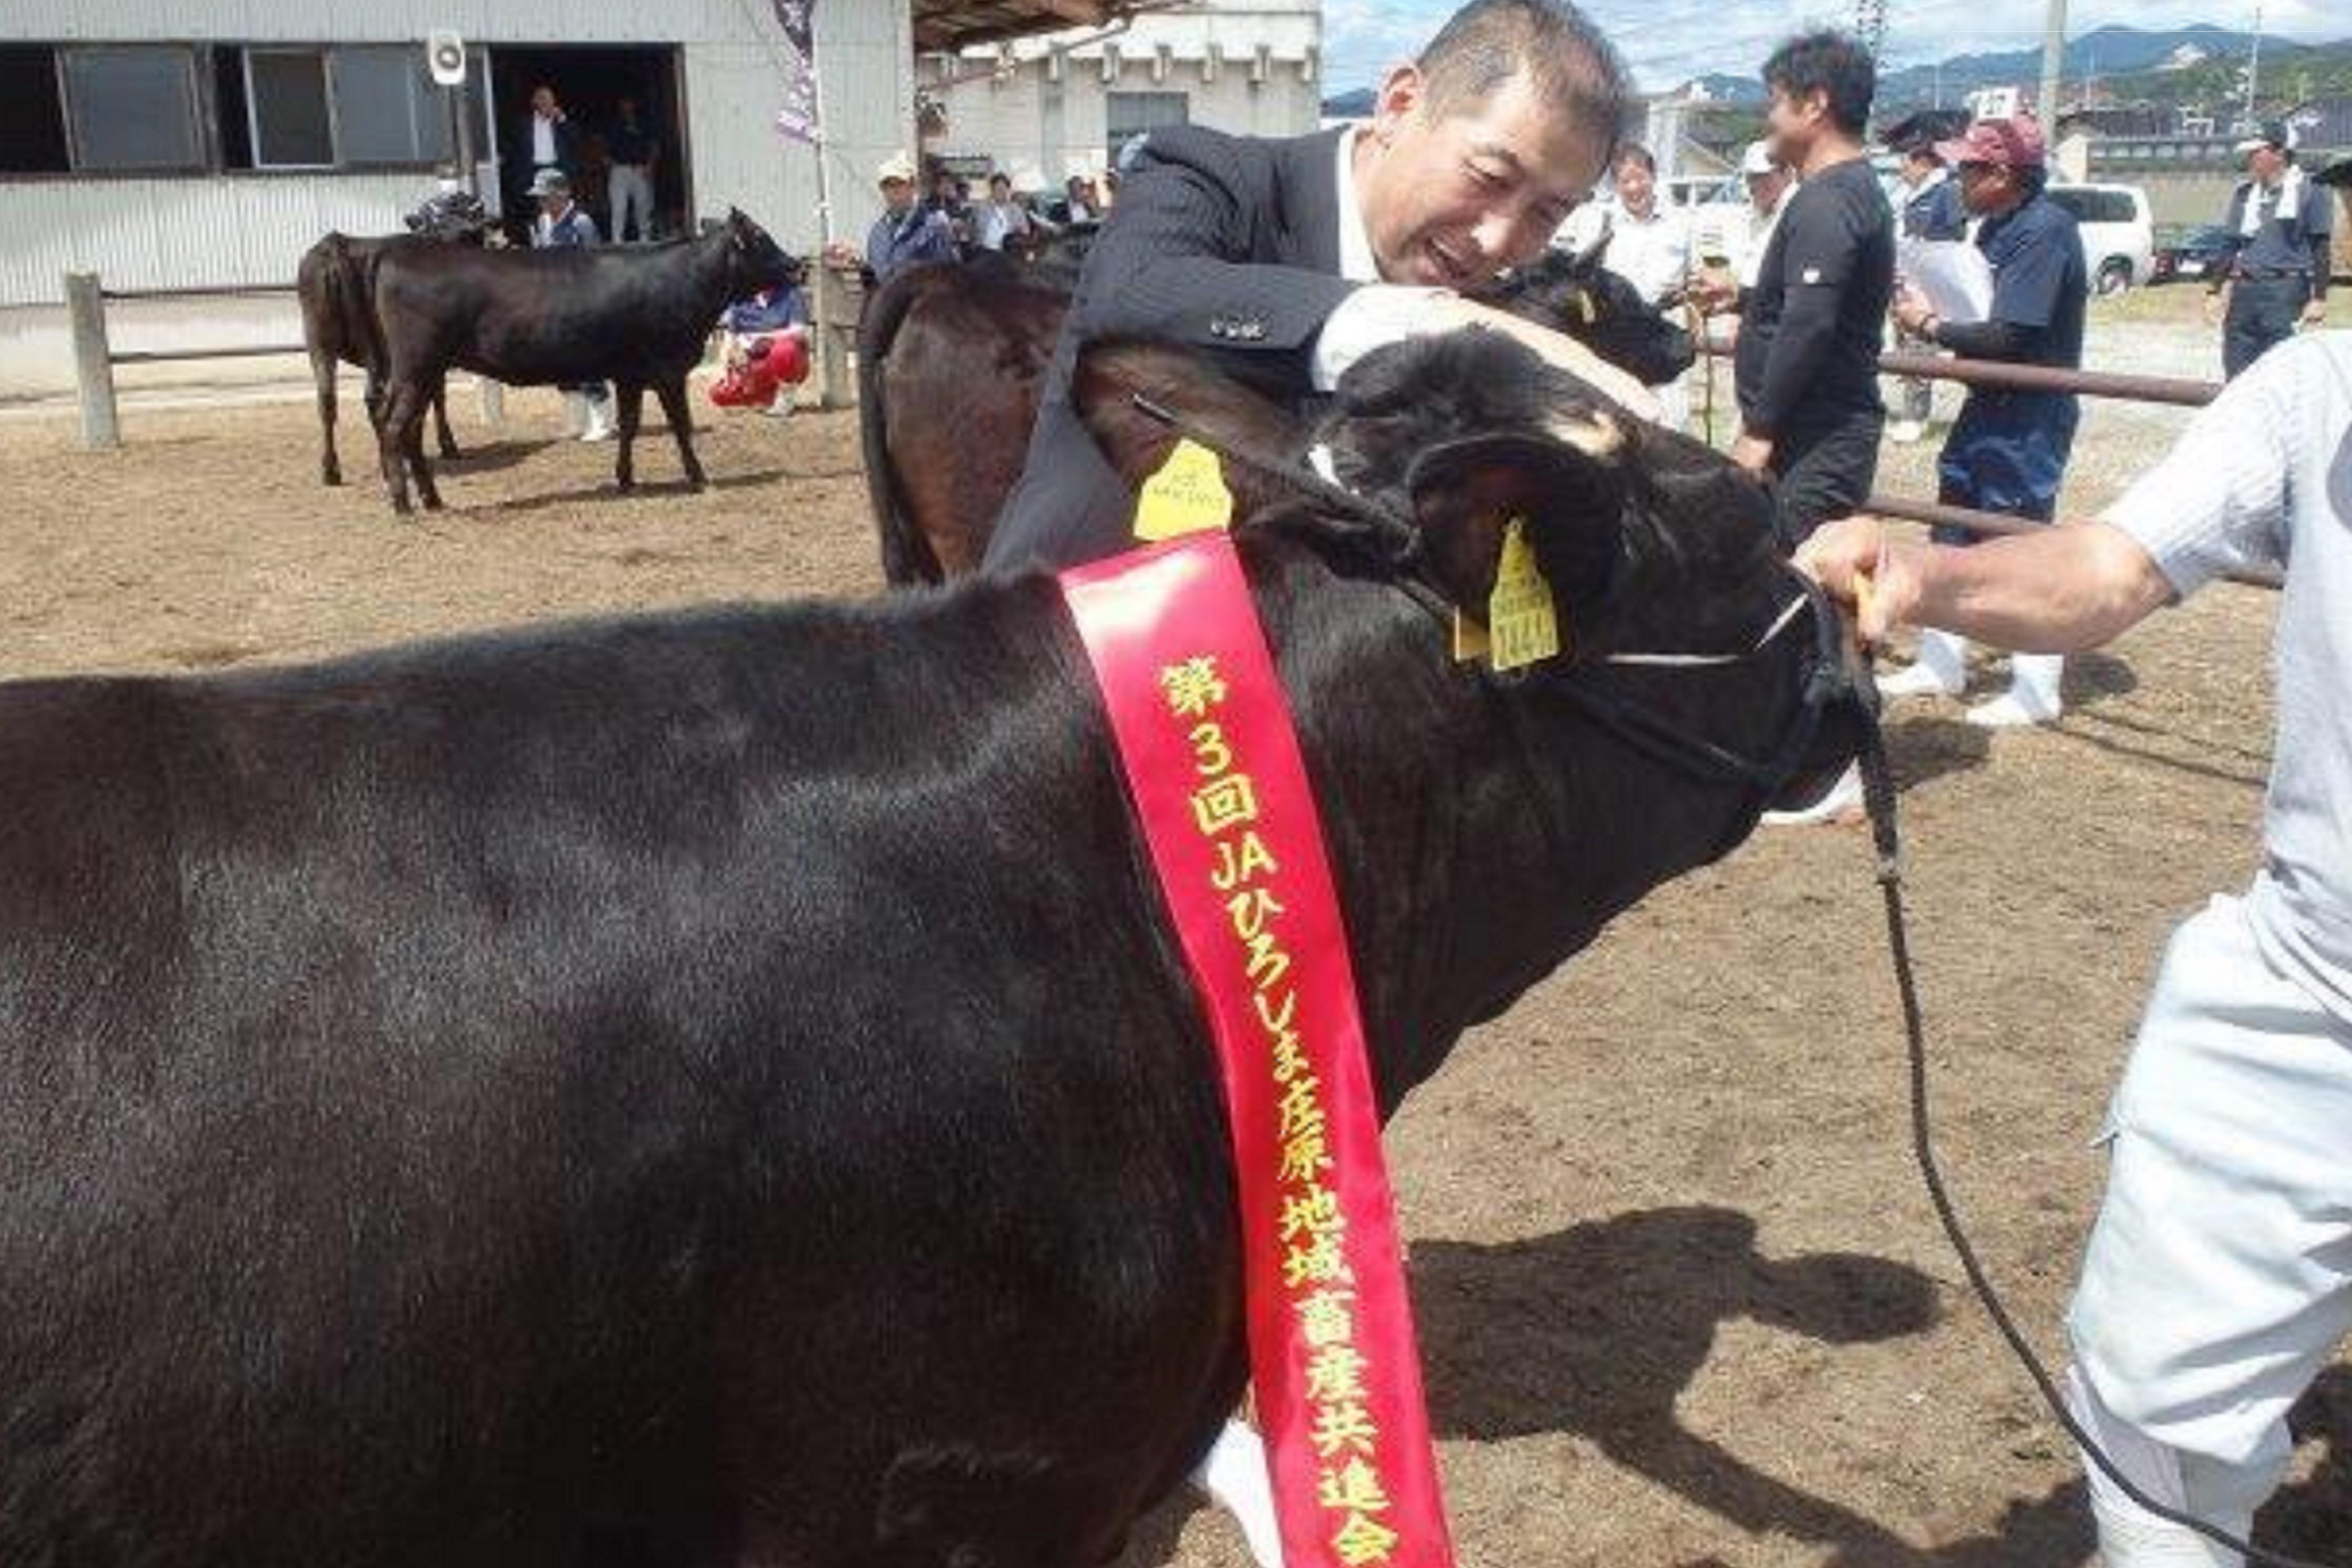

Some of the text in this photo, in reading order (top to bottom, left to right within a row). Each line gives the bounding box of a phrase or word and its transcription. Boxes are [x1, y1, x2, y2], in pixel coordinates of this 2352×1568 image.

[1161, 655, 1398, 1566] 第3回JAひろしま庄原地域畜産共進会
